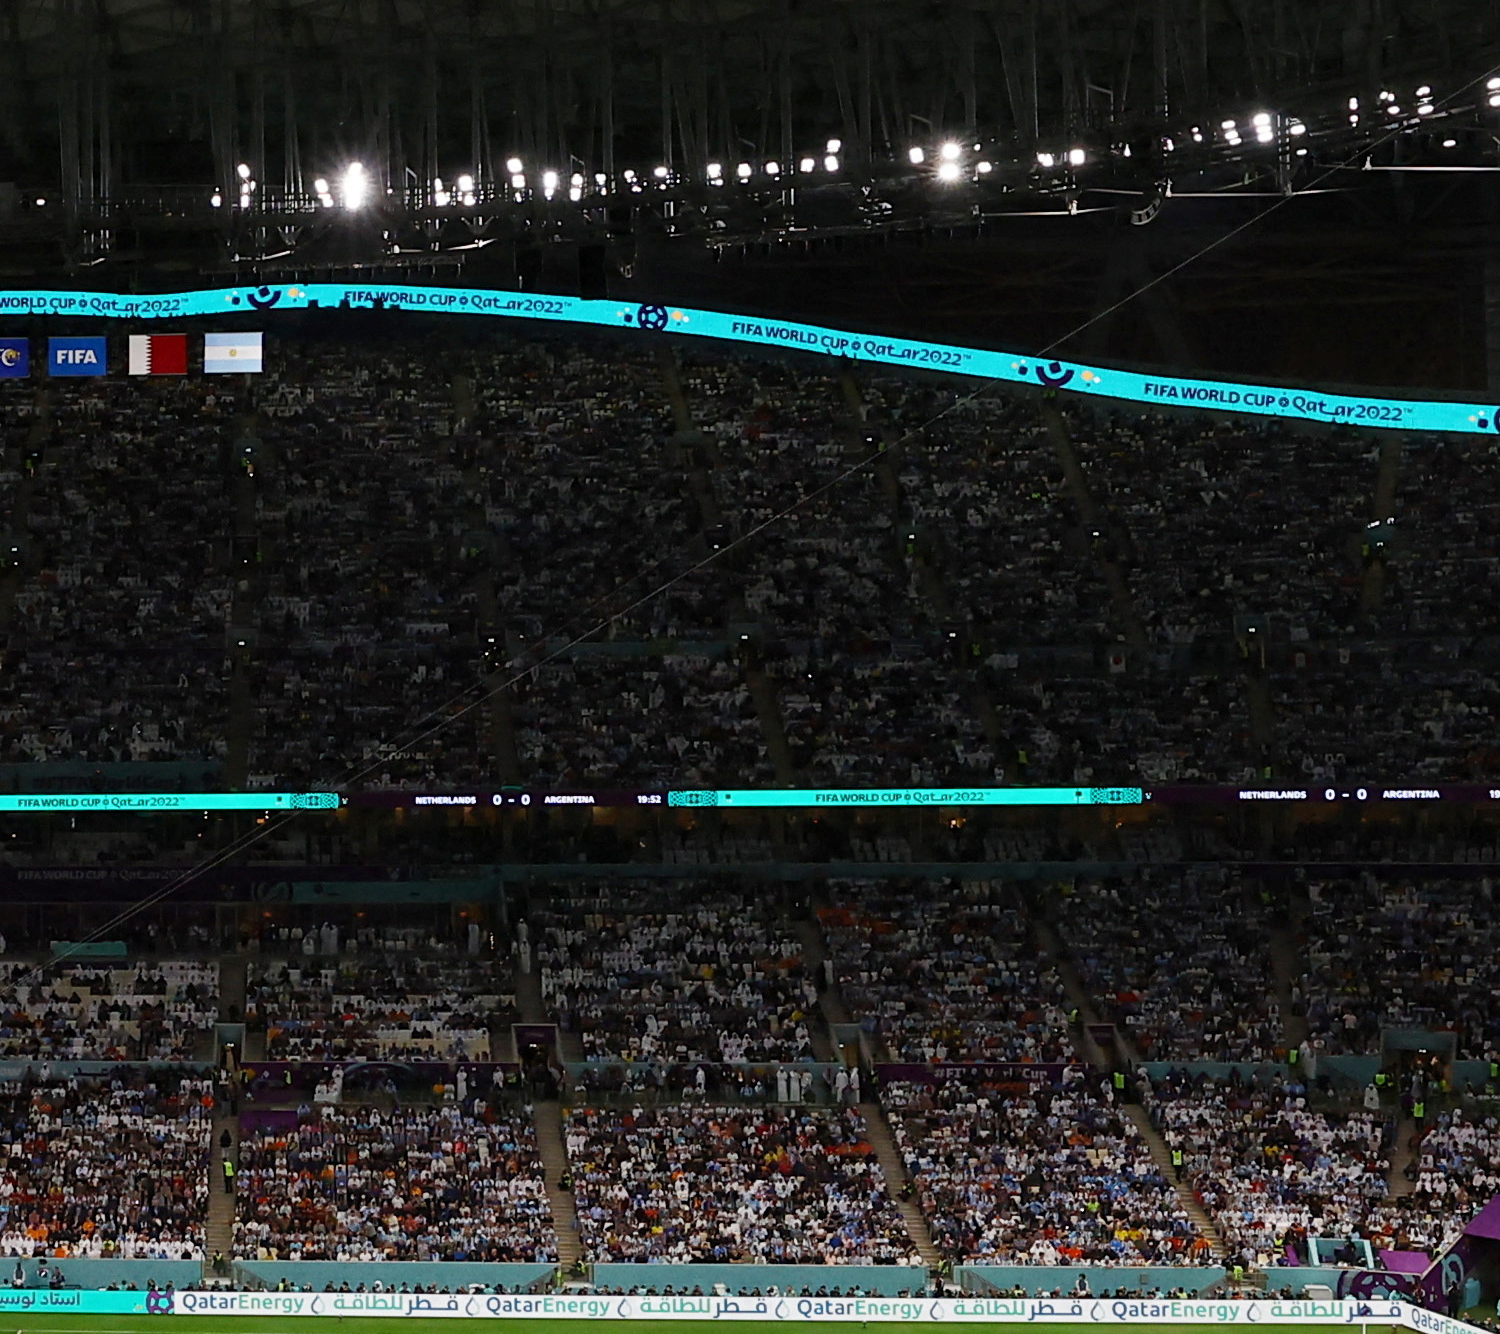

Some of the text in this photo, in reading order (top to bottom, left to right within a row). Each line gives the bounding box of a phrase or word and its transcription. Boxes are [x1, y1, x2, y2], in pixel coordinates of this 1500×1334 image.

[733, 322, 763, 336] FIFA
[766, 326, 818, 344] WORLD
[821, 336, 849, 349] CUP
[56, 349, 97, 365] FIFA
[183, 1294, 303, 1313] QatarEnergy
[334, 1295, 458, 1315] قطر للطاقة
[1112, 1302, 1239, 1321] QatarEnergy
